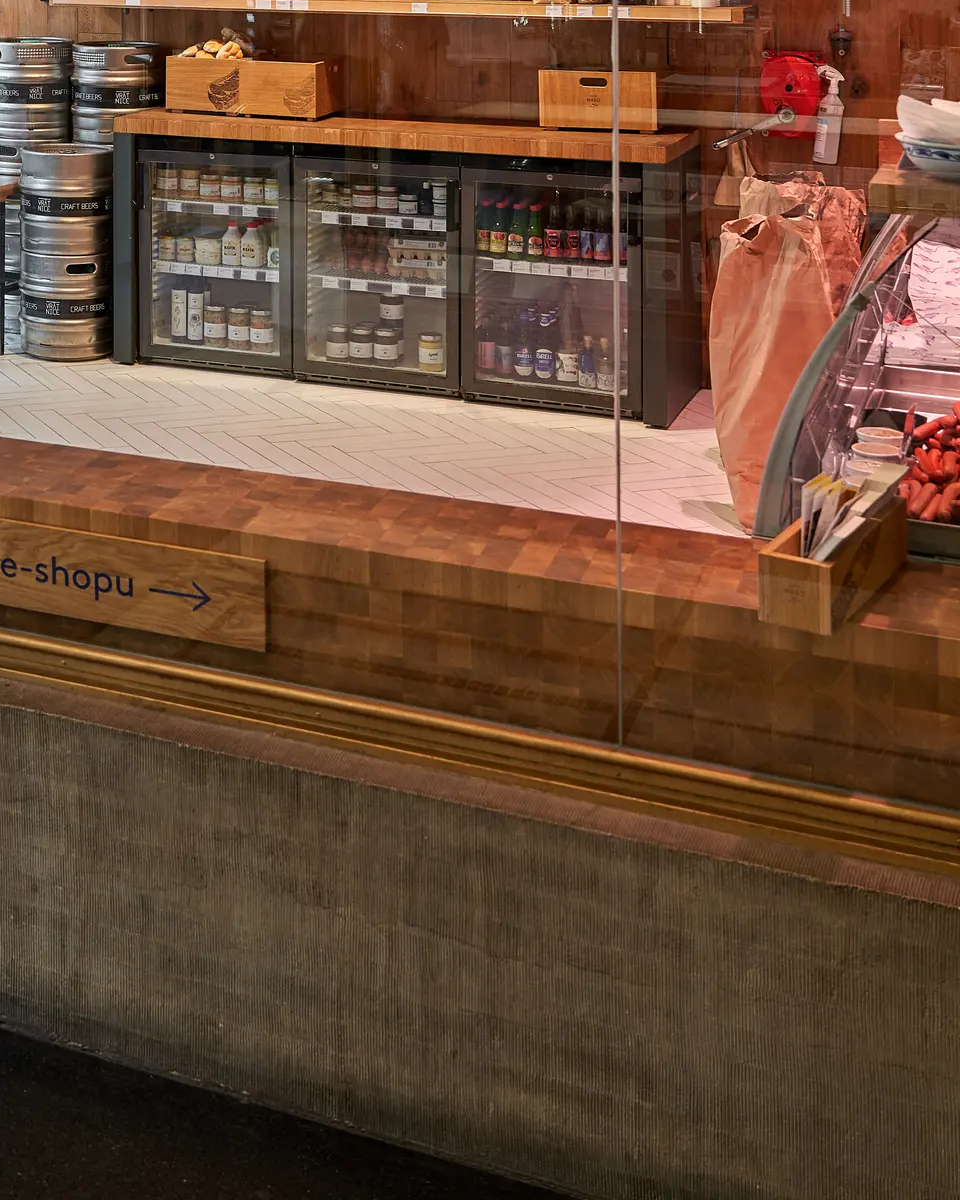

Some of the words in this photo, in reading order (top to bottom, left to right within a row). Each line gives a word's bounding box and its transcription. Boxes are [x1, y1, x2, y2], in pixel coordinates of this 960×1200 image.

[60, 202, 80, 210] CRAFT
[81, 202, 98, 210] BEERS
[70, 304, 88, 312] CRAFT
[89, 302, 105, 311] BEERS
[45, 308, 60, 316] NICE
[0, 555, 135, 601] e-shopu
